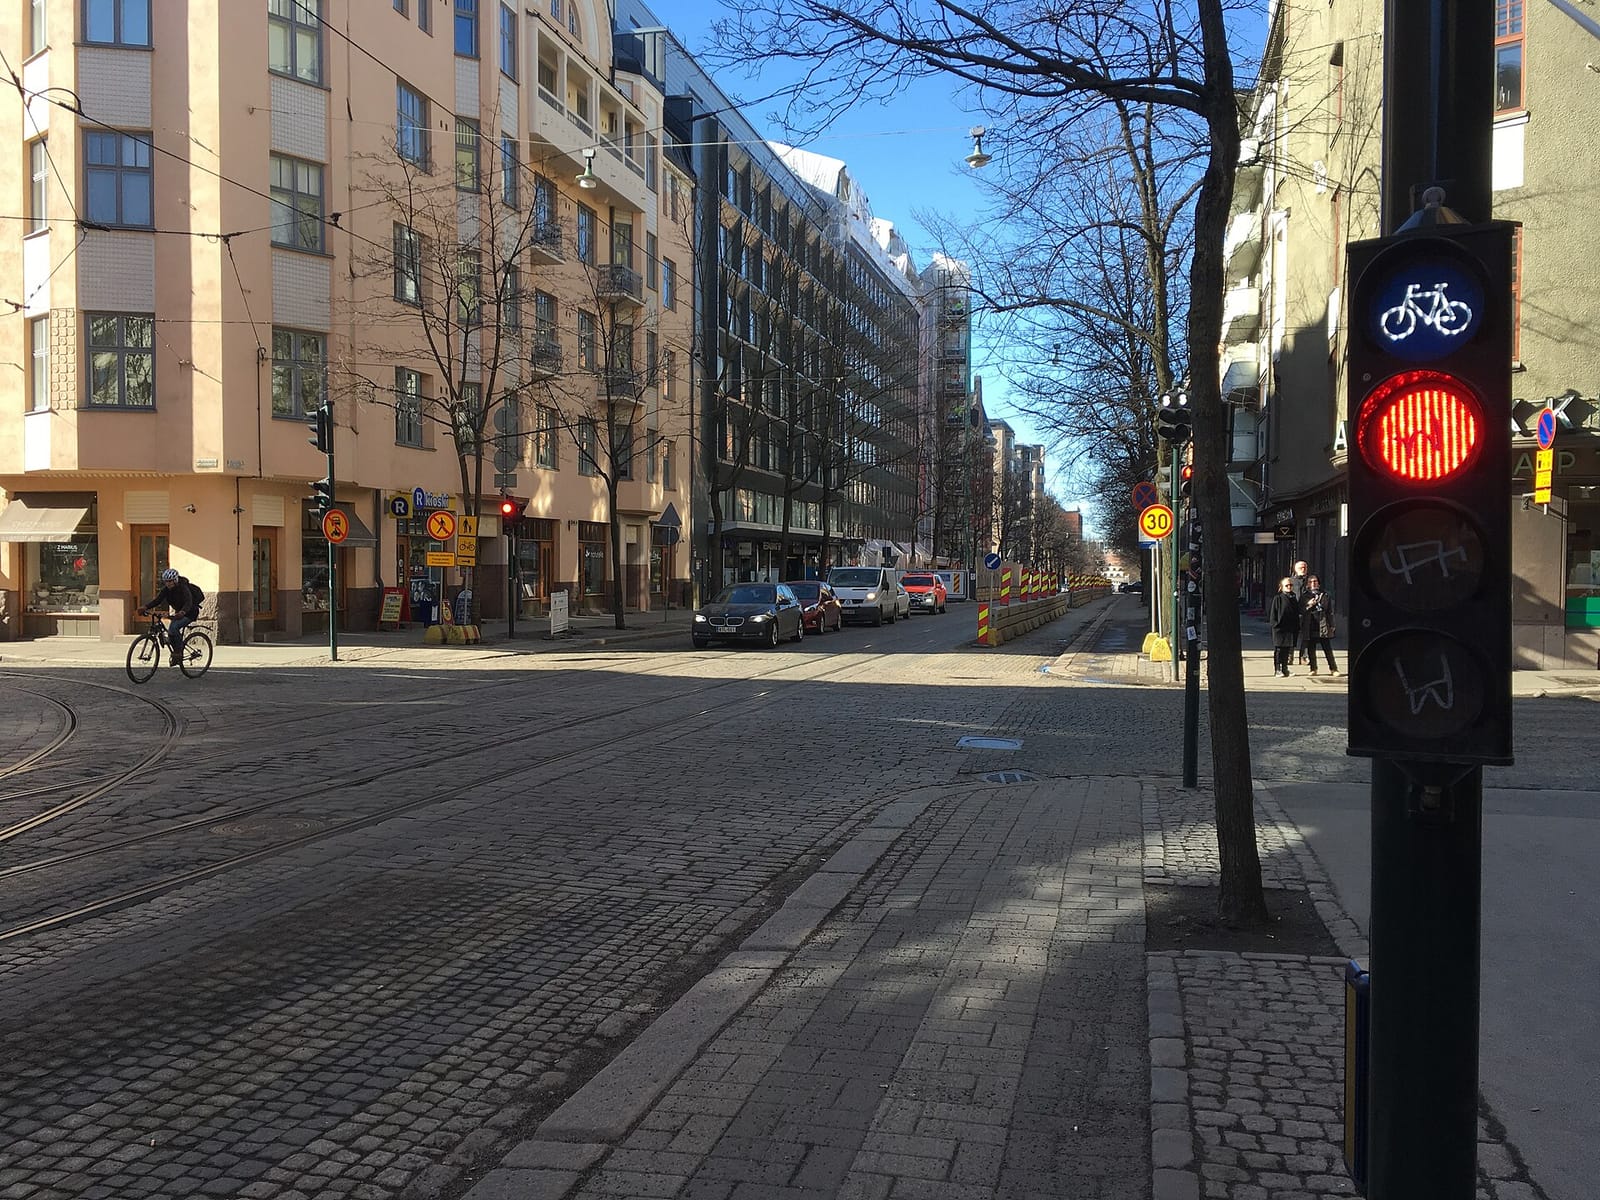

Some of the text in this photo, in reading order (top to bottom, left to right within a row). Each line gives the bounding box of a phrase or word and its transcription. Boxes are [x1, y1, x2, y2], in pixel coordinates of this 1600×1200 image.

[1513, 452, 1600, 476] AP
[416, 492, 423, 506] R
[395, 501, 405, 514] R
[1147, 514, 1168, 529] 30
